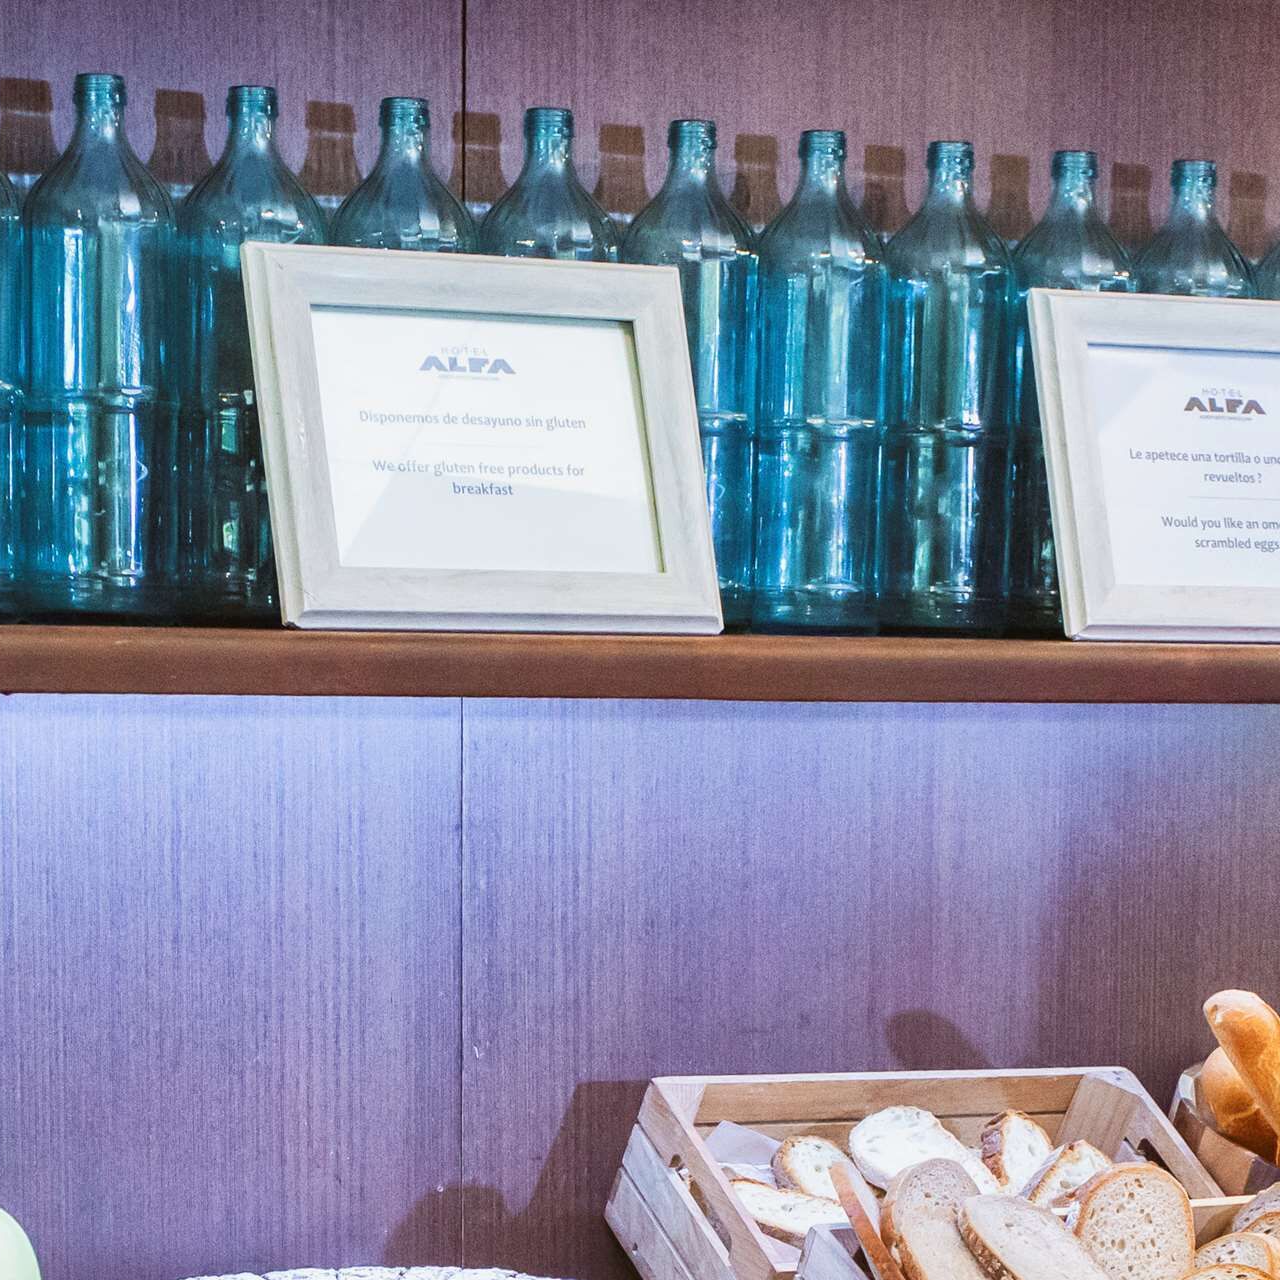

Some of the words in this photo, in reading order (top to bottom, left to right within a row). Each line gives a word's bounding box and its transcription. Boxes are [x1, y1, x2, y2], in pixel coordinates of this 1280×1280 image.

[418, 355, 516, 375] ALFA
[1183, 396, 1267, 415] ALFA
[359, 410, 440, 425] Disponemos
[443, 412, 458, 424] de
[462, 413, 522, 429] desayuno
[525, 414, 543, 427] sin
[546, 416, 587, 431] gluten
[1129, 448, 1143, 460] Le
[1145, 451, 1189, 464] apetece
[1191, 453, 1212, 463] una
[1214, 452, 1251, 464] tortilla
[1253, 456, 1261, 465] o
[372, 459, 395, 472] We
[398, 460, 429, 473] offer
[433, 461, 475, 477] gluten
[479, 462, 505, 475] free
[508, 463, 564, 479] products
[567, 464, 585, 477] for
[1204, 471, 1255, 483] revueltos
[452, 482, 513, 496] breakfast
[1161, 516, 1199, 529] Would
[1201, 520, 1221, 531] you
[1224, 517, 1244, 529] like
[1246, 520, 1259, 530] an
[1195, 537, 1252, 550] scrambled
[1254, 540, 1280, 553] eggs
